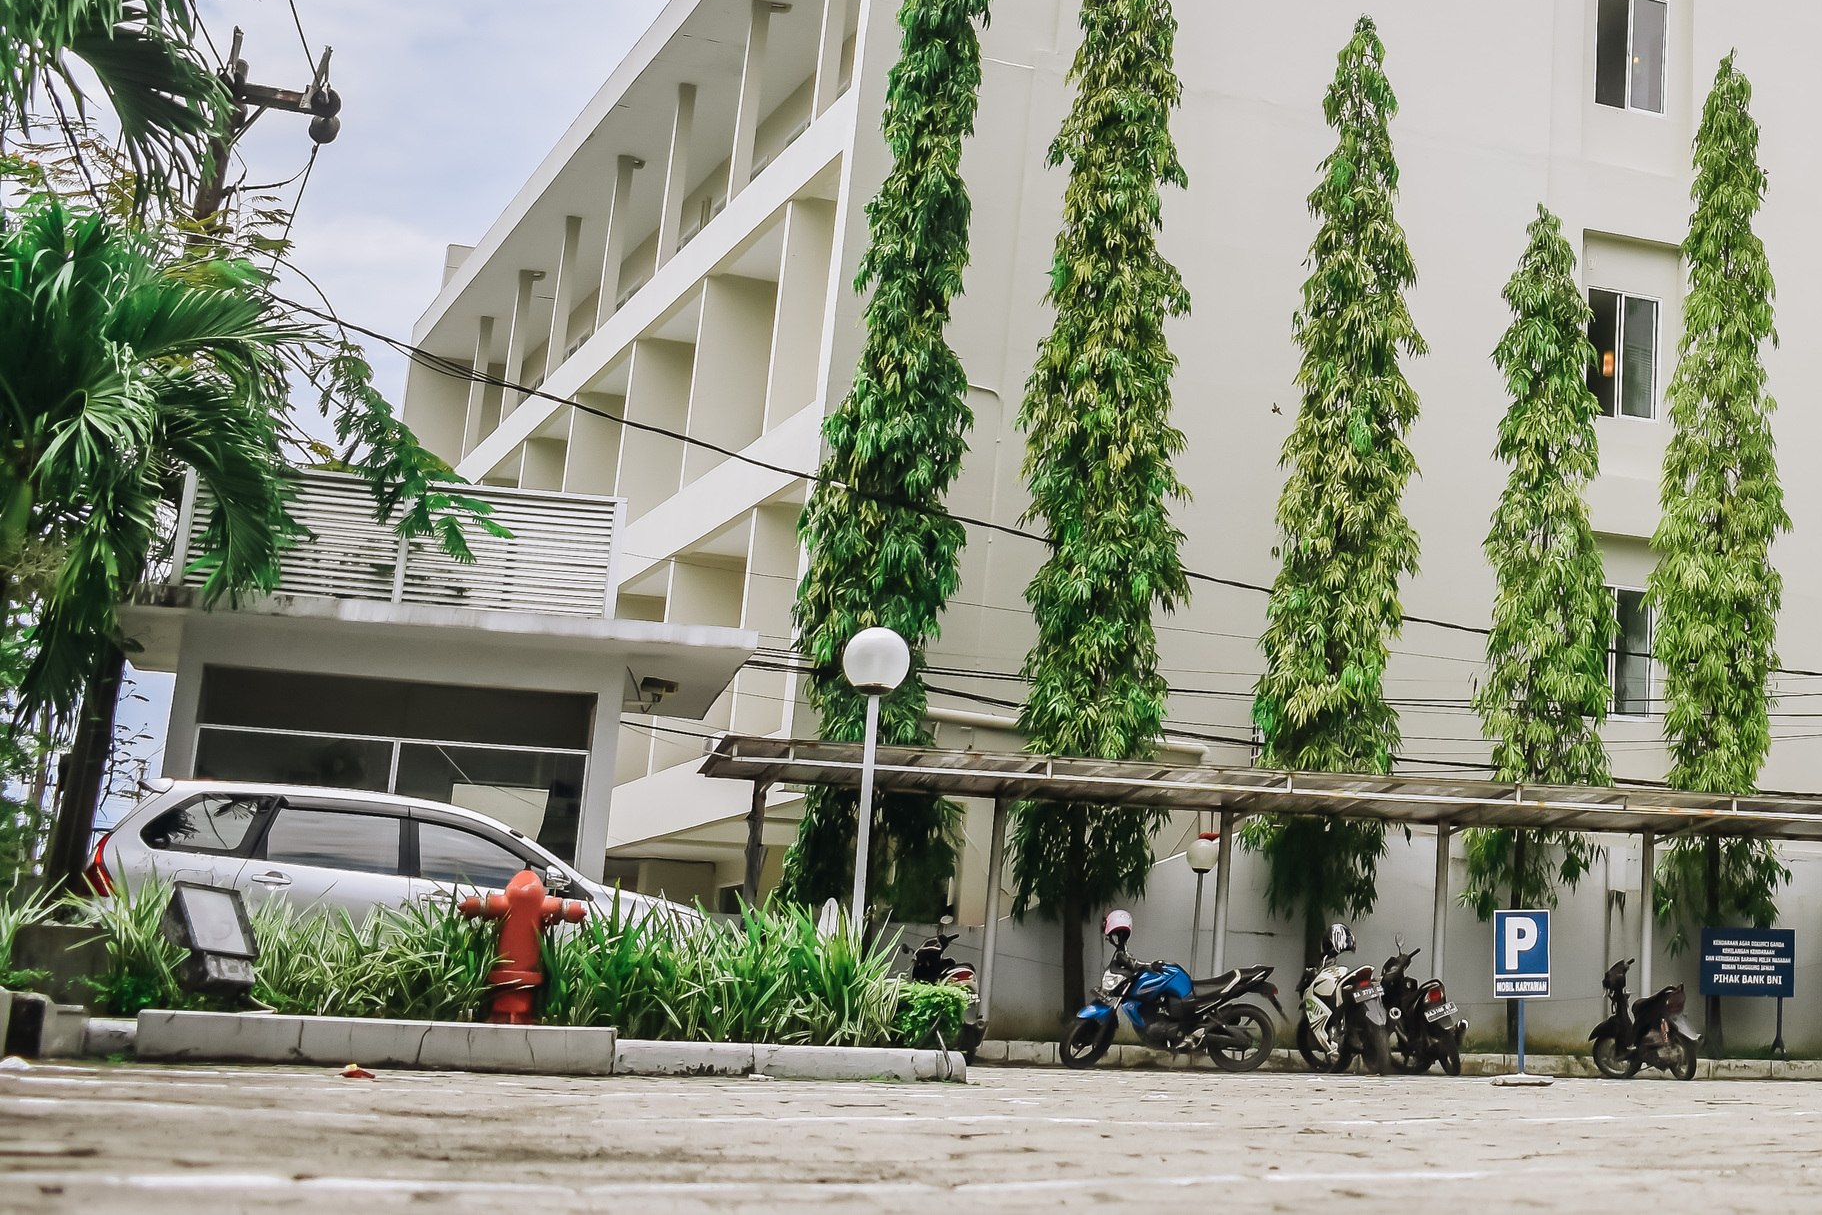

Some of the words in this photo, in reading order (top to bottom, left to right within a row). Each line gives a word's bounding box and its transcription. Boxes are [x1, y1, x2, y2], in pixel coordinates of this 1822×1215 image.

[1505, 916, 1538, 970] P
[1713, 974, 1740, 984] PIHAK
[1742, 974, 1765, 984] BANK
[1767, 975, 1782, 985] BNI
[1497, 981, 1514, 992] MOBIL
[1515, 981, 1547, 992] KARYAWAN
